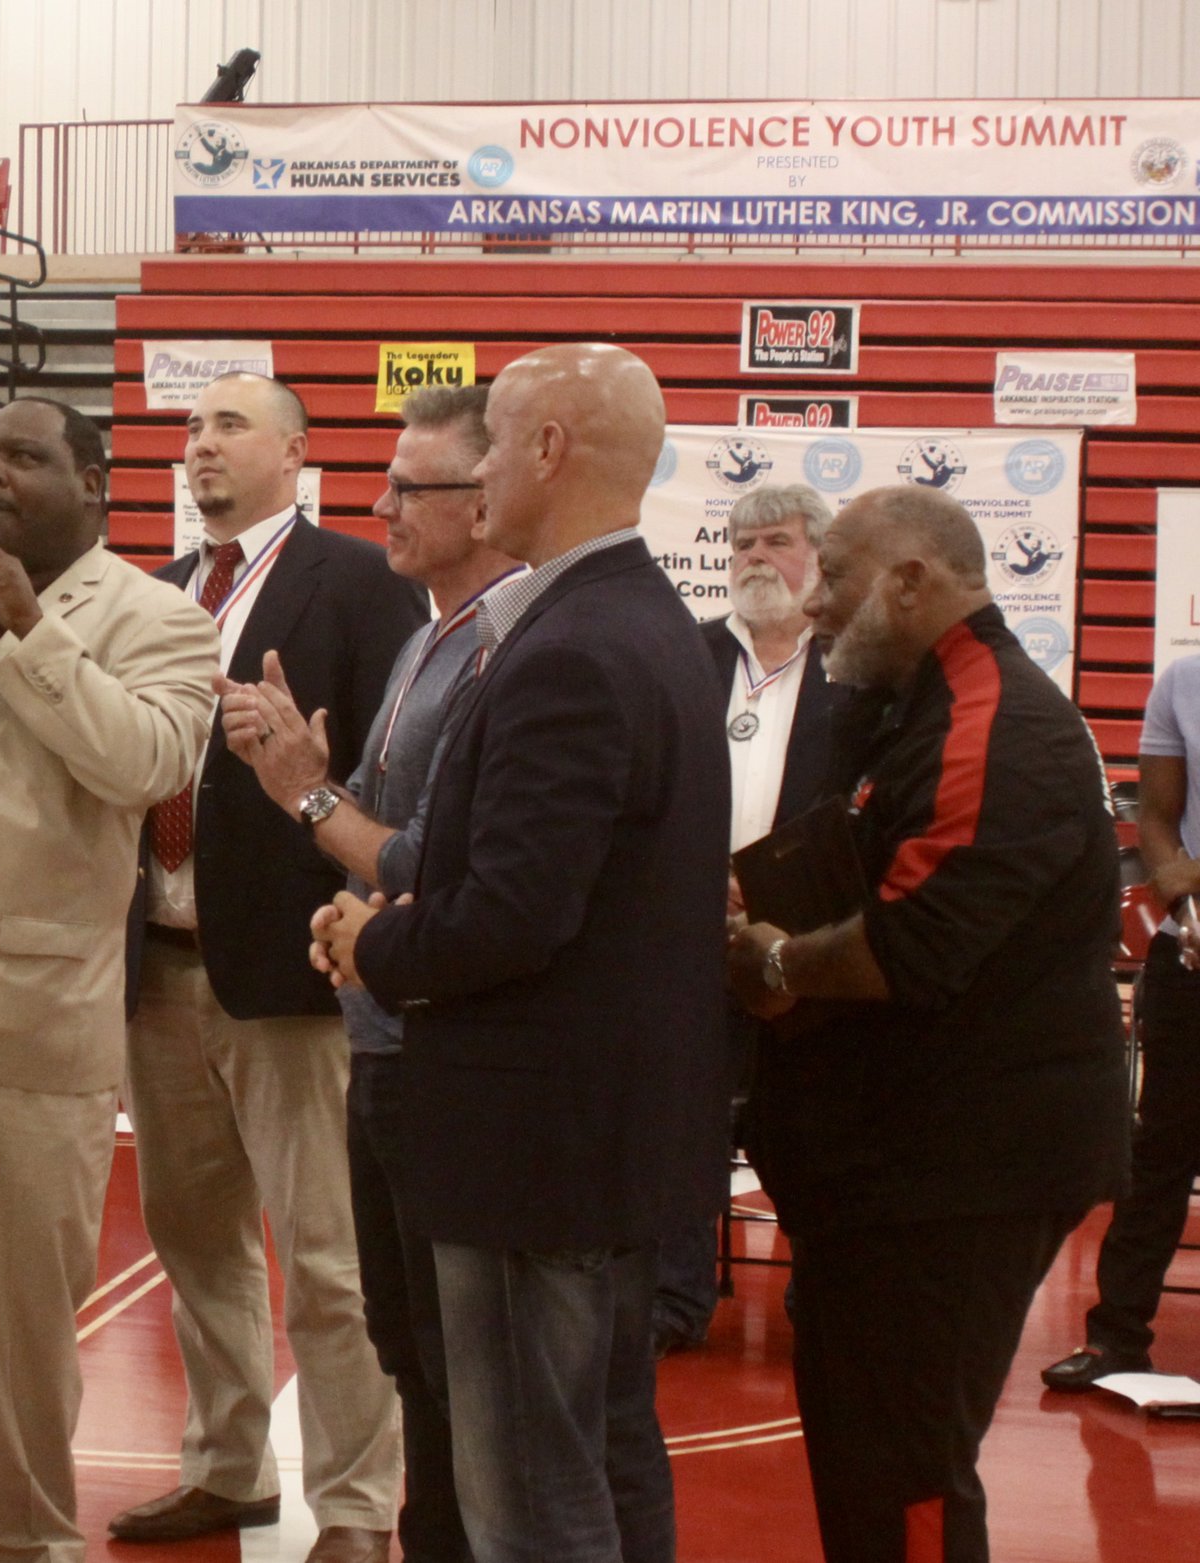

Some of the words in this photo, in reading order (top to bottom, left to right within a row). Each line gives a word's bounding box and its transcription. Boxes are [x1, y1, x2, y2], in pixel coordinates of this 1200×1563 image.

[520, 116, 810, 148] NONVIOLENCE
[825, 116, 956, 147] YOUTH
[971, 115, 1127, 146] SUMMIT
[290, 160, 356, 170] ARKANSAS
[360, 160, 440, 170] DEPARTMENT
[443, 160, 459, 170] OF
[757, 155, 839, 169] PRESENTED
[290, 173, 364, 188] HUMAN
[370, 172, 461, 187] SERVICES
[788, 175, 806, 188] BY
[448, 200, 601, 225] ARKANSAS
[610, 200, 721, 225] MARTIN
[732, 200, 831, 225] LUTHER
[841, 200, 926, 228] KING,
[935, 200, 976, 226] JR.
[987, 200, 1196, 226] COMMISSION
[755, 310, 807, 348] POWER
[807, 310, 835, 348] 92
[386, 351, 402, 360] The
[406, 351, 459, 361] Legendary
[754, 349, 768, 361] The
[769, 349, 799, 364] People's
[800, 349, 825, 362] Station
[995, 365, 1085, 392] PRAISE
[1040, 396, 1086, 404] INSPIRATION
[705, 498, 736, 506] NONV
[705, 509, 730, 517] YOUT
[969, 510, 991, 518] UTH
[994, 510, 1032, 518] SUMMIT
[1000, 604, 1021, 612] UTH
[1023, 604, 1062, 612] SUMMIT
